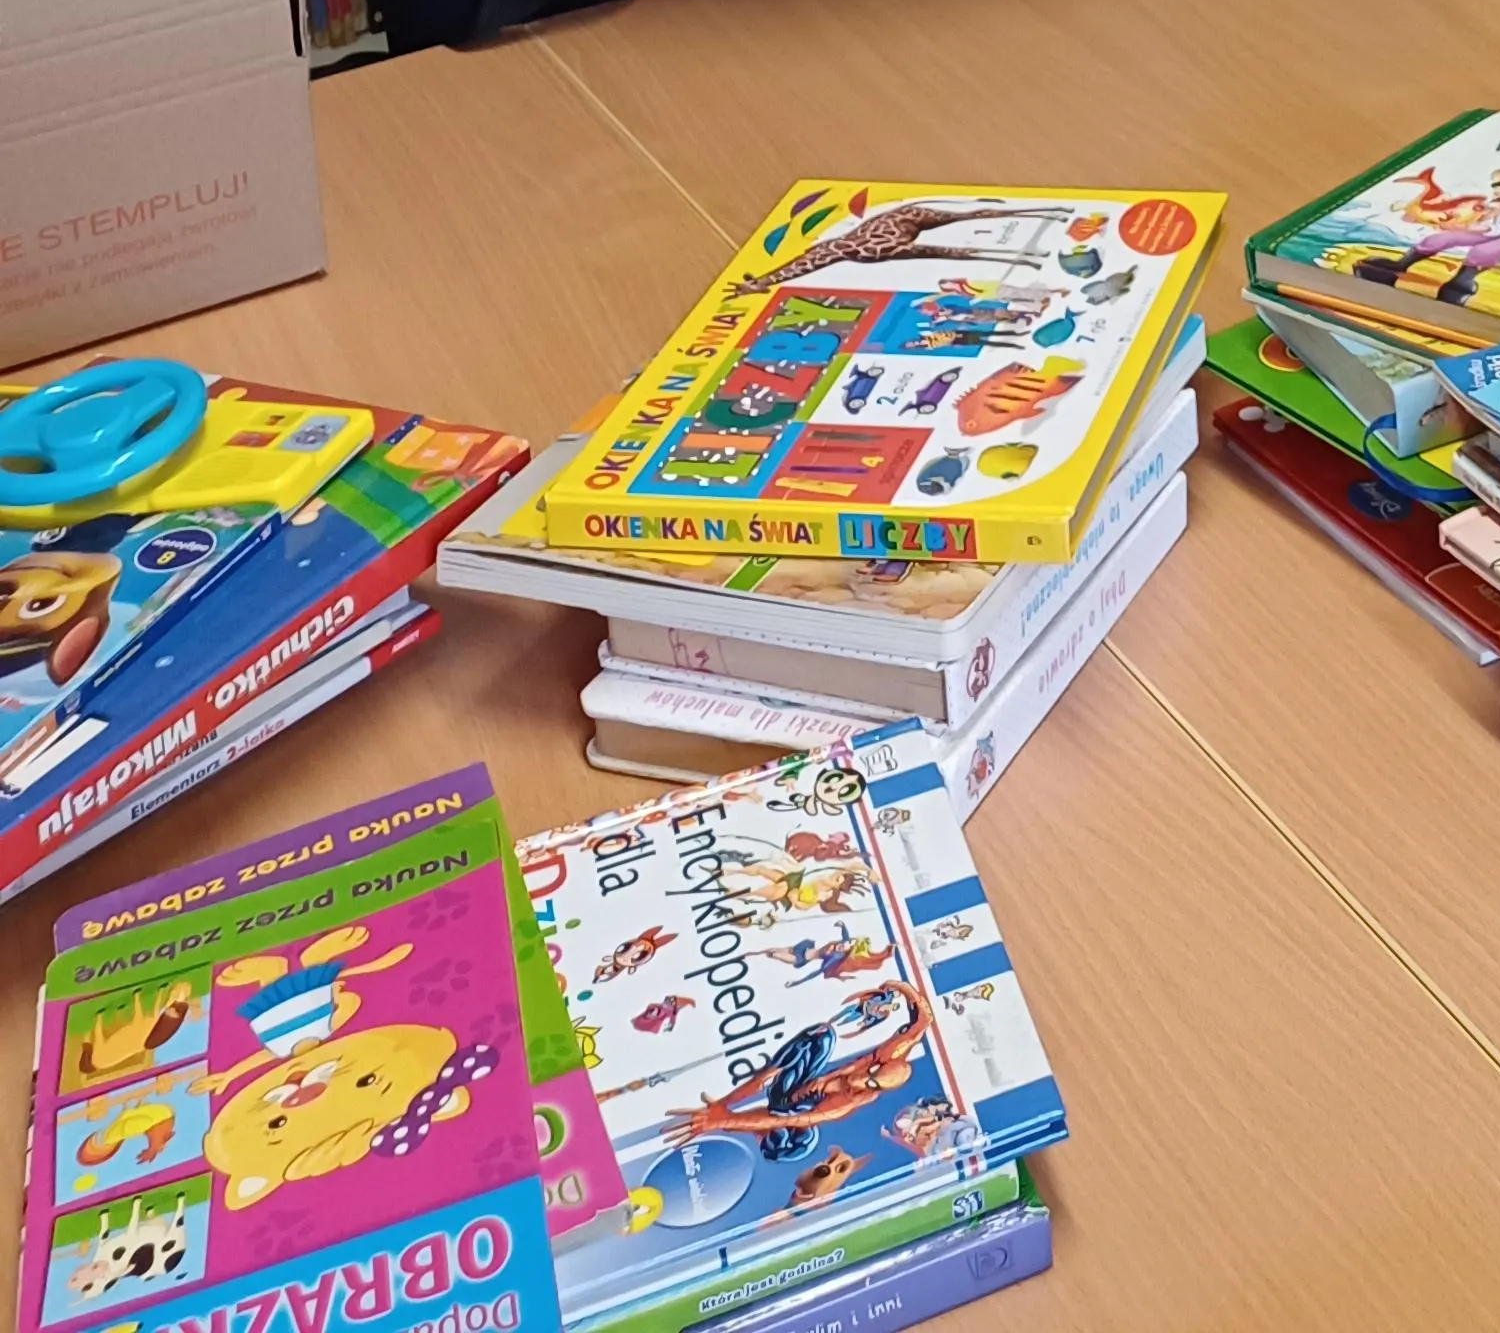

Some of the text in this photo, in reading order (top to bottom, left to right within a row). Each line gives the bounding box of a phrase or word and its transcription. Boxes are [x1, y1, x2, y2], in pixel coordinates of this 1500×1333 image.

[37, 170, 249, 251] STEMPLUJ!
[584, 396, 684, 490] OKIENKA
[657, 362, 713, 391] NA
[584, 513, 970, 553] OKIENKA NA ŚWIAT LICZBY
[37, 594, 355, 845] Cichutko, Mikołaju
[645, 689, 744, 720] maluchów
[129, 716, 286, 821] Elementarz 2-latka
[82, 792, 463, 940] Nauka przez zabawę
[591, 832, 657, 896] dla
[74, 850, 469, 984] Nauka przez zabawę
[666, 802, 784, 1087] Encyklopedia
[699, 1248, 846, 1314] Która jest godzina?
[867, 1293, 903, 1318] inni
